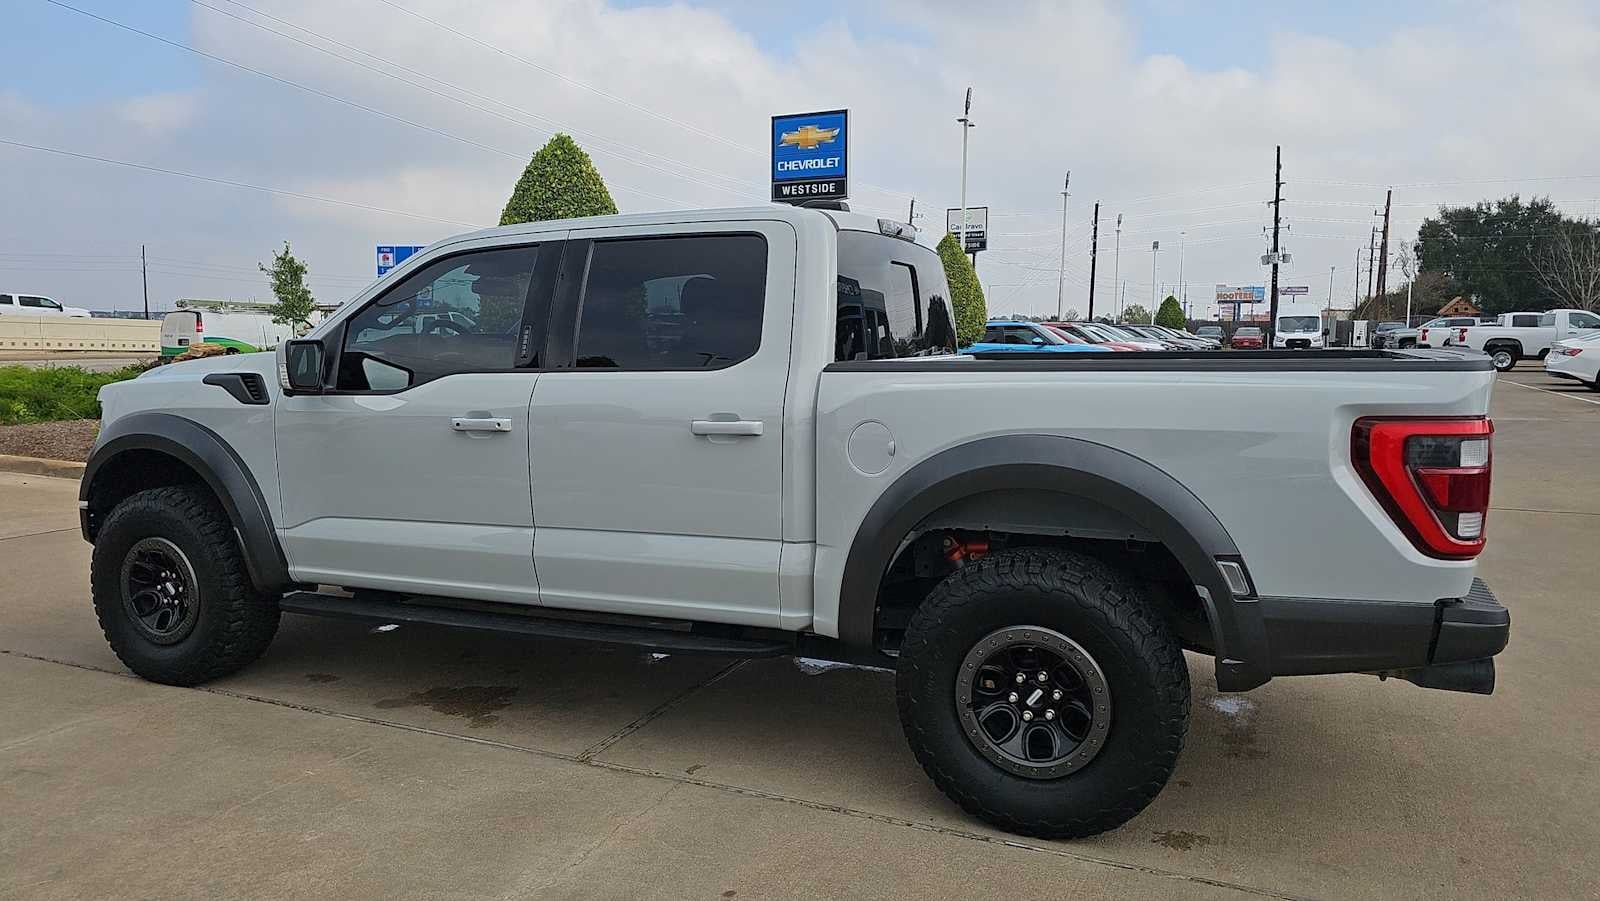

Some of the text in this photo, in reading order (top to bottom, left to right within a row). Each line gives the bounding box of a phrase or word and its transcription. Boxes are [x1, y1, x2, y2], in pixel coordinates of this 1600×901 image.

[777, 157, 840, 171] CHEVROLET
[782, 183, 836, 195] WESTSIDE
[1216, 292, 1253, 300] HOOTERS
